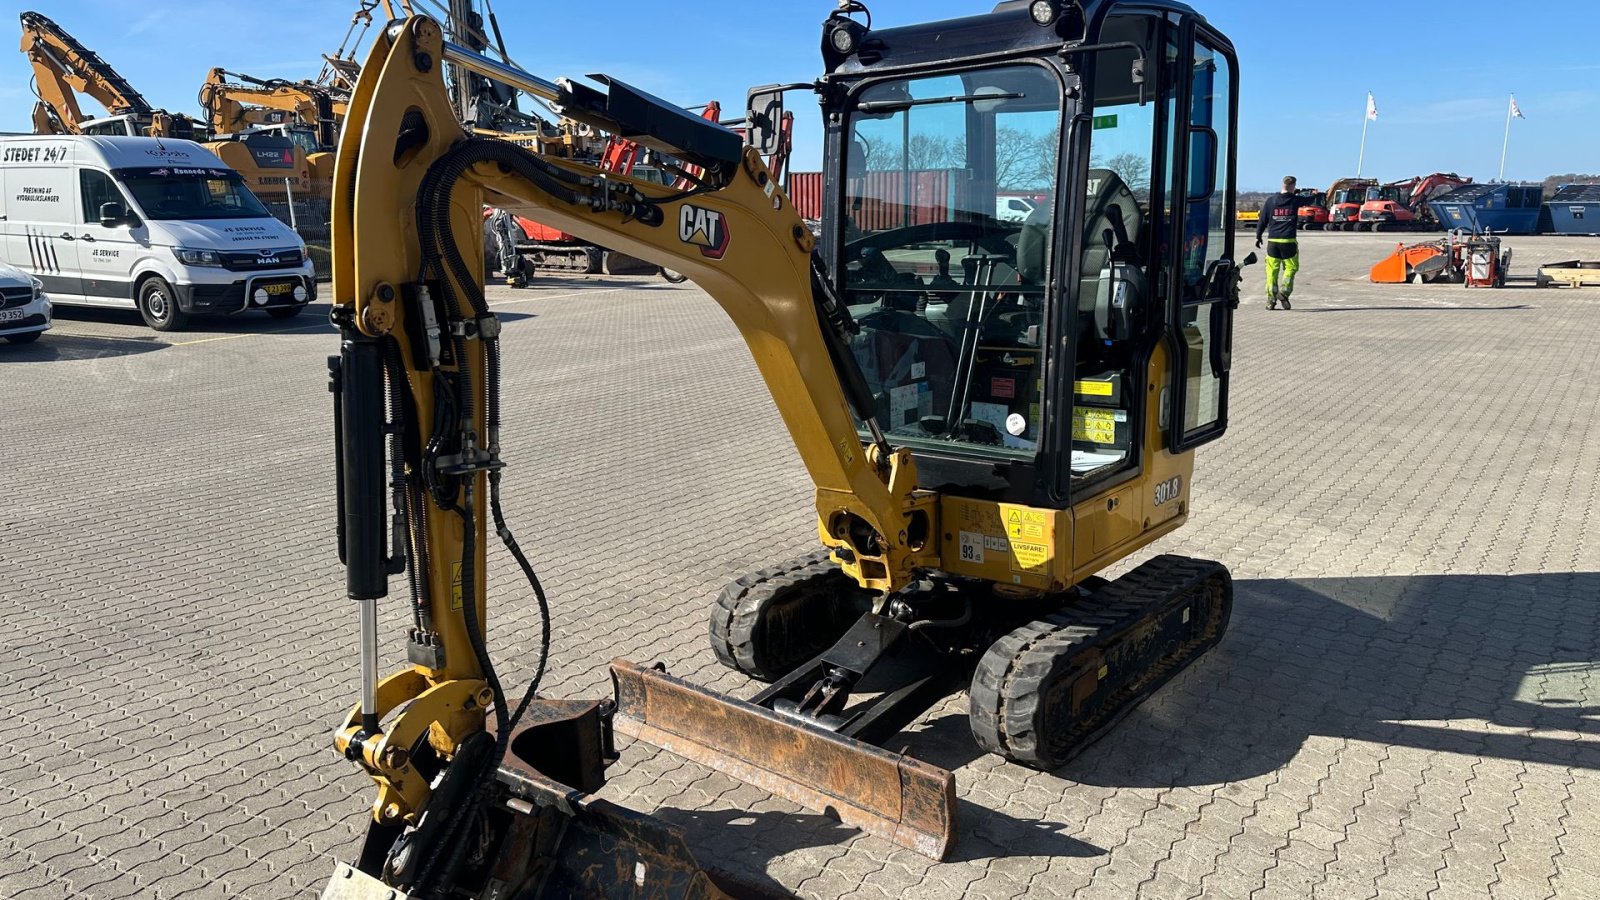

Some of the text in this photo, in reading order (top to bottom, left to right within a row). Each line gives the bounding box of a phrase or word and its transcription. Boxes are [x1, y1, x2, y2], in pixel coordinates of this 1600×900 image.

[4, 145, 67, 164] STEDET 24/7
[680, 204, 719, 247] CAT
[99, 249, 120, 257] SERVICE
[8, 310, 22, 319] 352
[1154, 478, 1179, 506] 301.8
[962, 544, 974, 559] 93
[1013, 544, 1045, 552] LIVSFARE!
